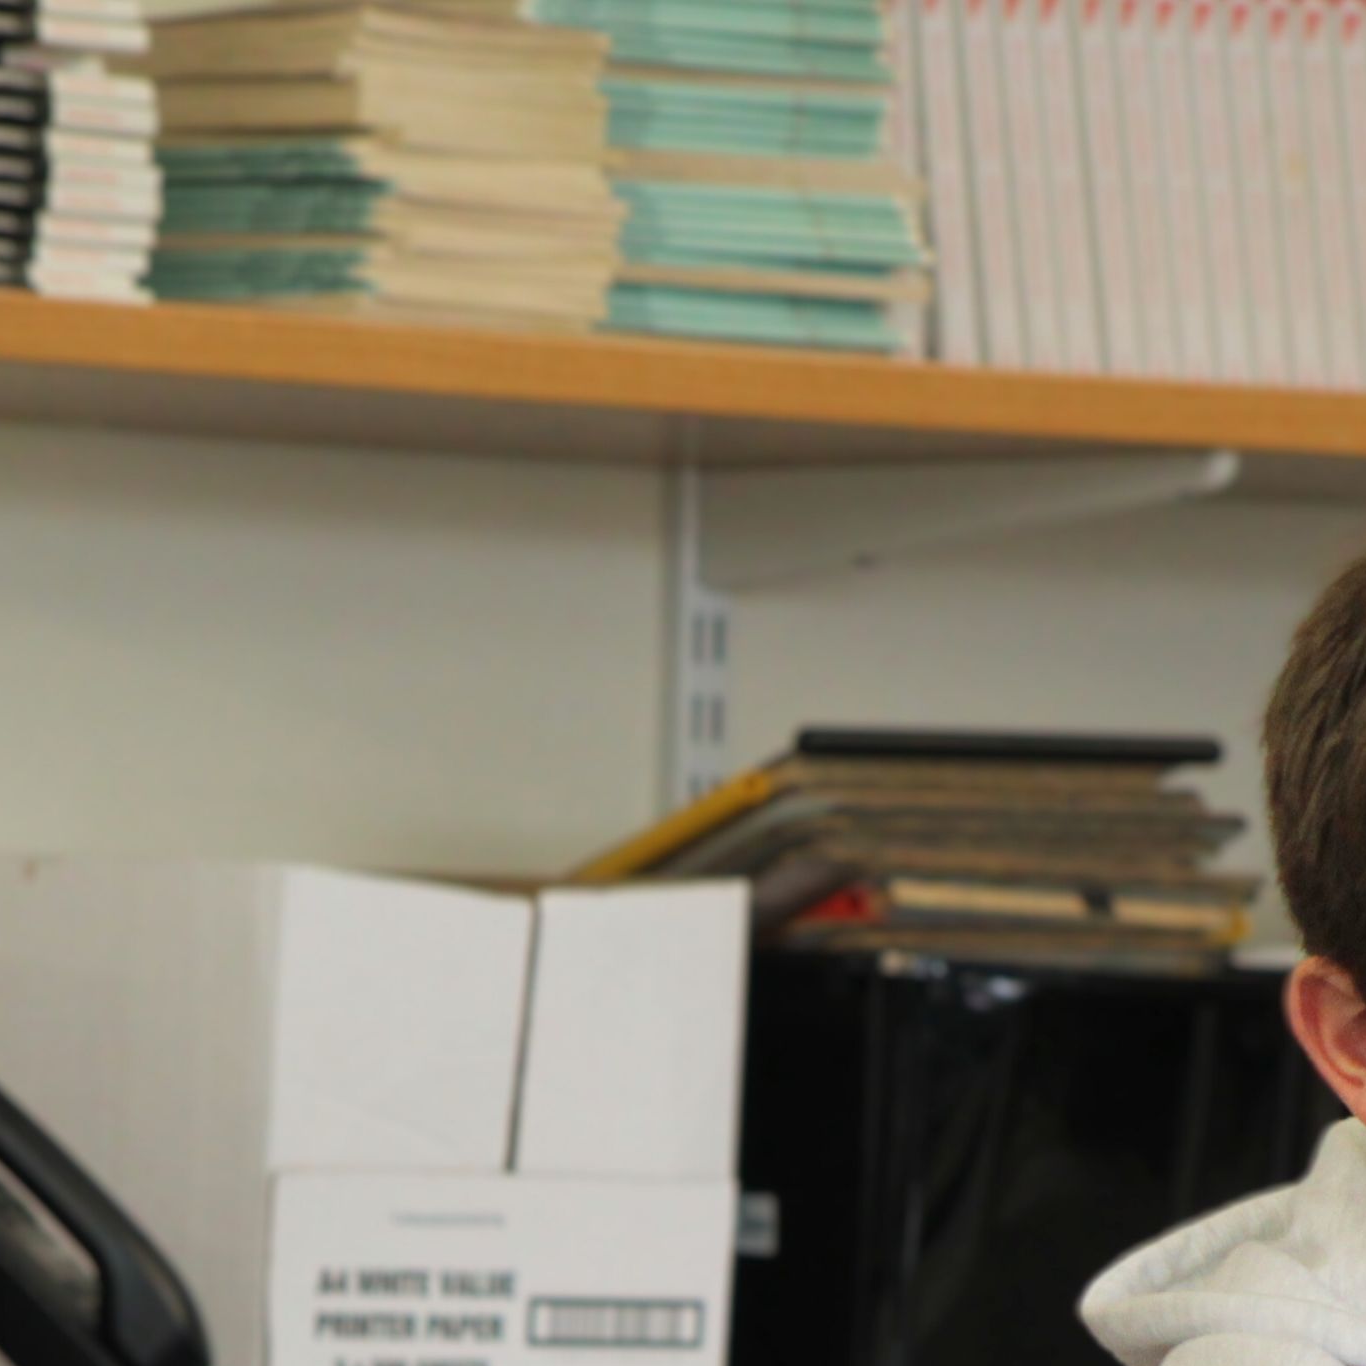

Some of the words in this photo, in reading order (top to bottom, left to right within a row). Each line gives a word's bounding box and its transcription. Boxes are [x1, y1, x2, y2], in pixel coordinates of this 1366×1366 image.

[317, 1267, 348, 1296] A4
[357, 1268, 429, 1297] WHITE
[439, 1270, 515, 1299] VALUE
[314, 1312, 415, 1340] PRINTER
[426, 1314, 505, 1343] PAPER
